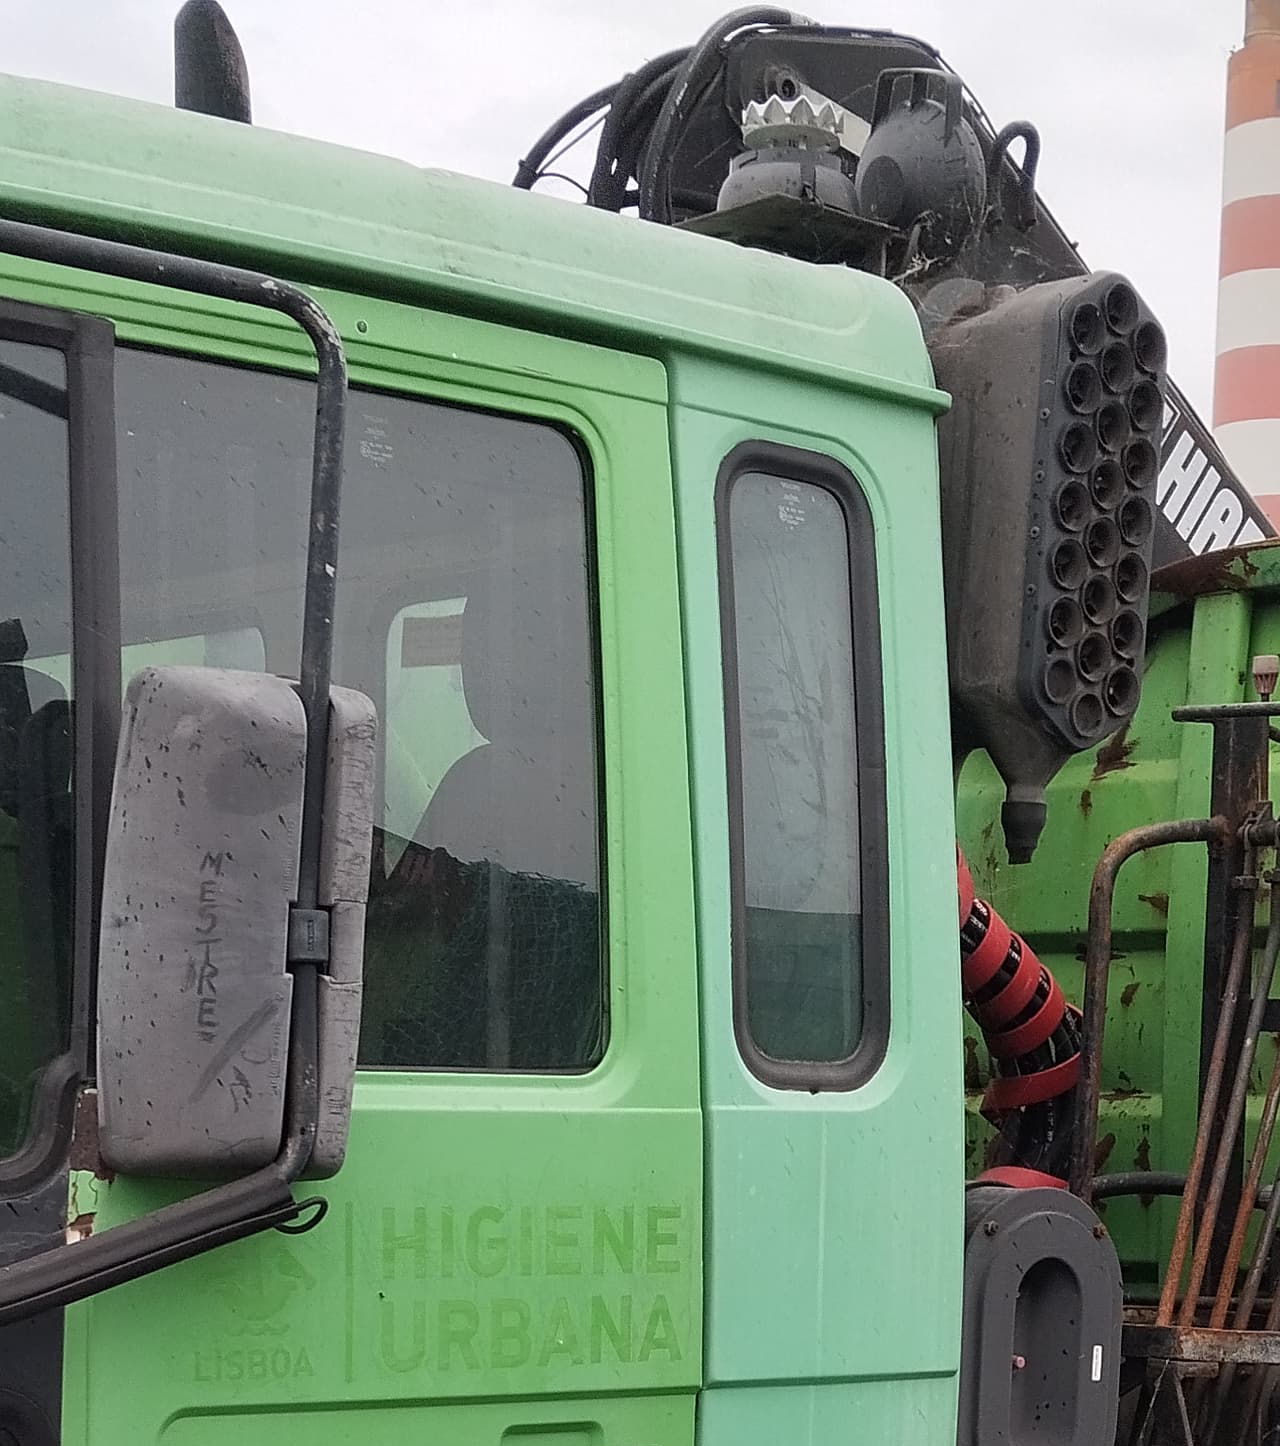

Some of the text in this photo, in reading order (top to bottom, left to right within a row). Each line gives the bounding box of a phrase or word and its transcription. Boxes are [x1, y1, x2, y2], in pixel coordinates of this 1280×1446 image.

[195, 851, 224, 1029] MESTRE
[381, 1205, 683, 1280] HIGIENE
[193, 1346, 315, 1384] LISBOA
[380, 1294, 683, 1374] URBANA
